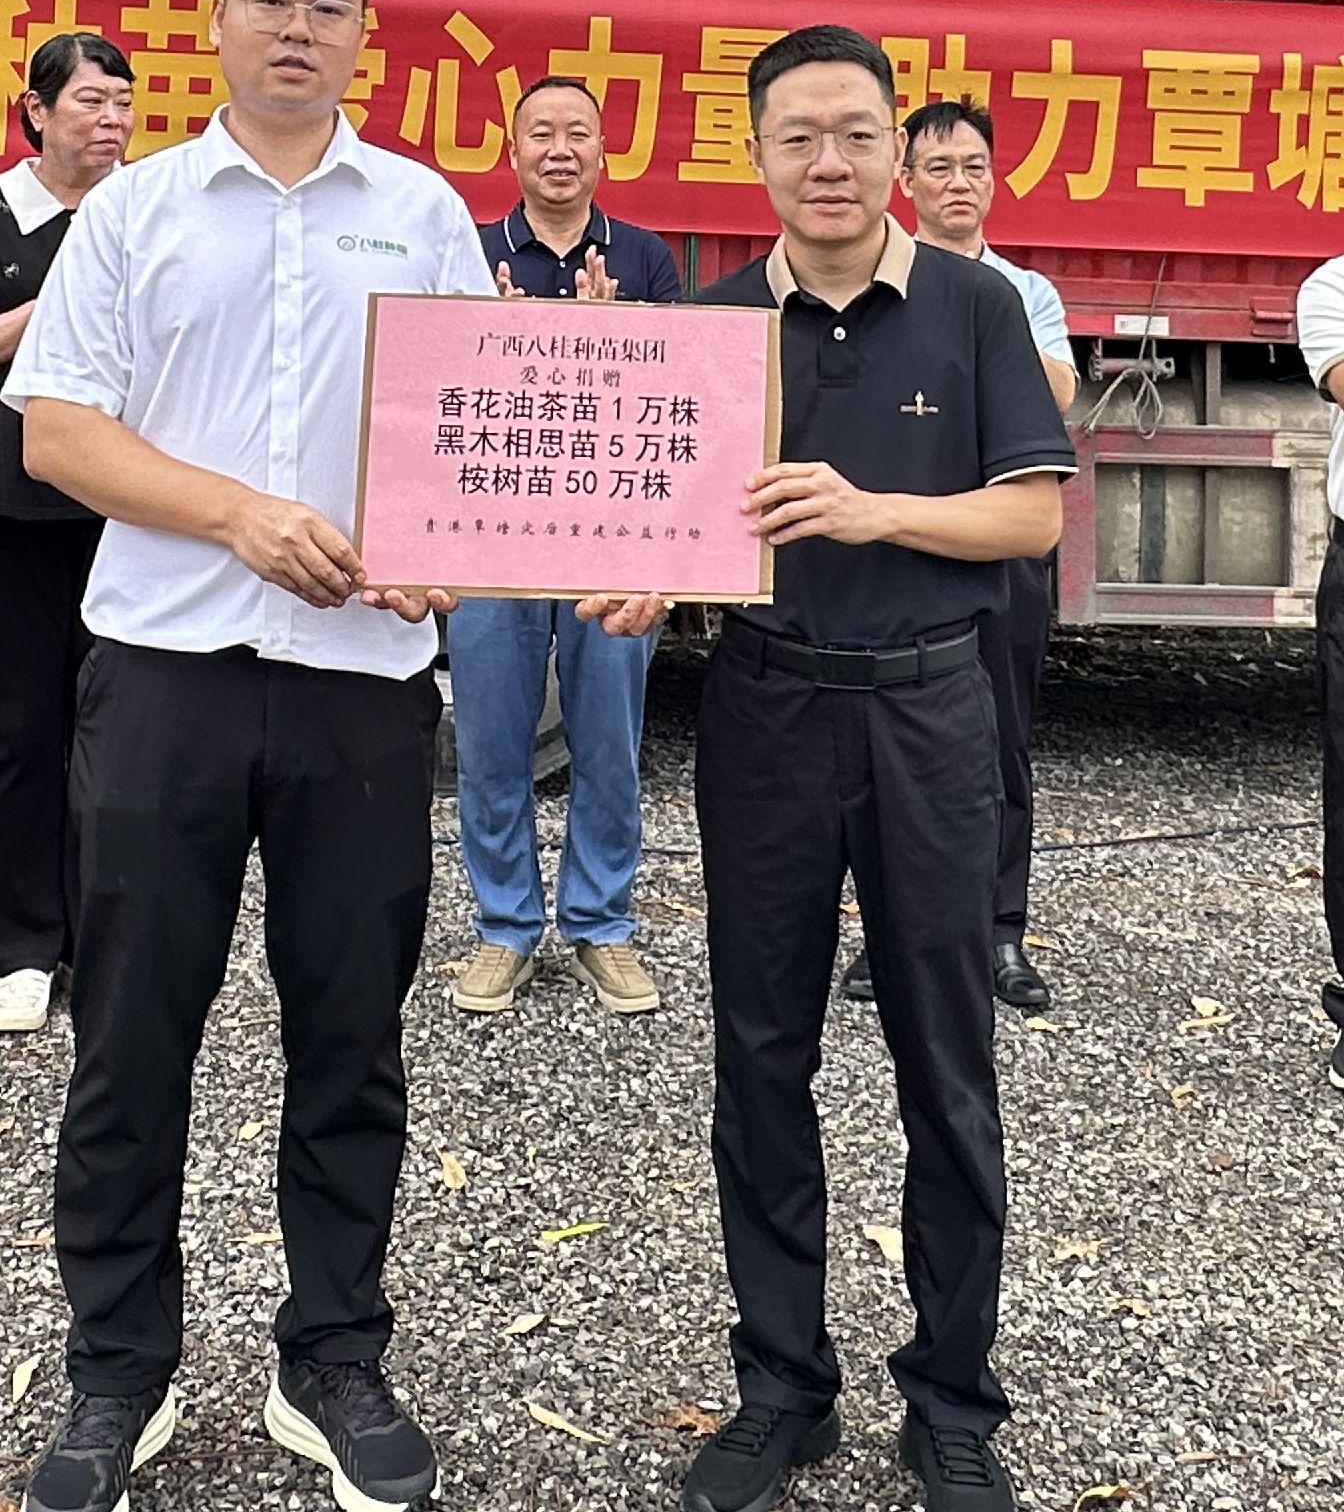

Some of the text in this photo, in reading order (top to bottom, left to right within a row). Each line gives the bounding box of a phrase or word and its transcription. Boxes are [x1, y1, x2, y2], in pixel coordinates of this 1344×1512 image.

[476, 332, 666, 364] 广西八桂种苗集团
[519, 365, 621, 388] 爱心捐赠
